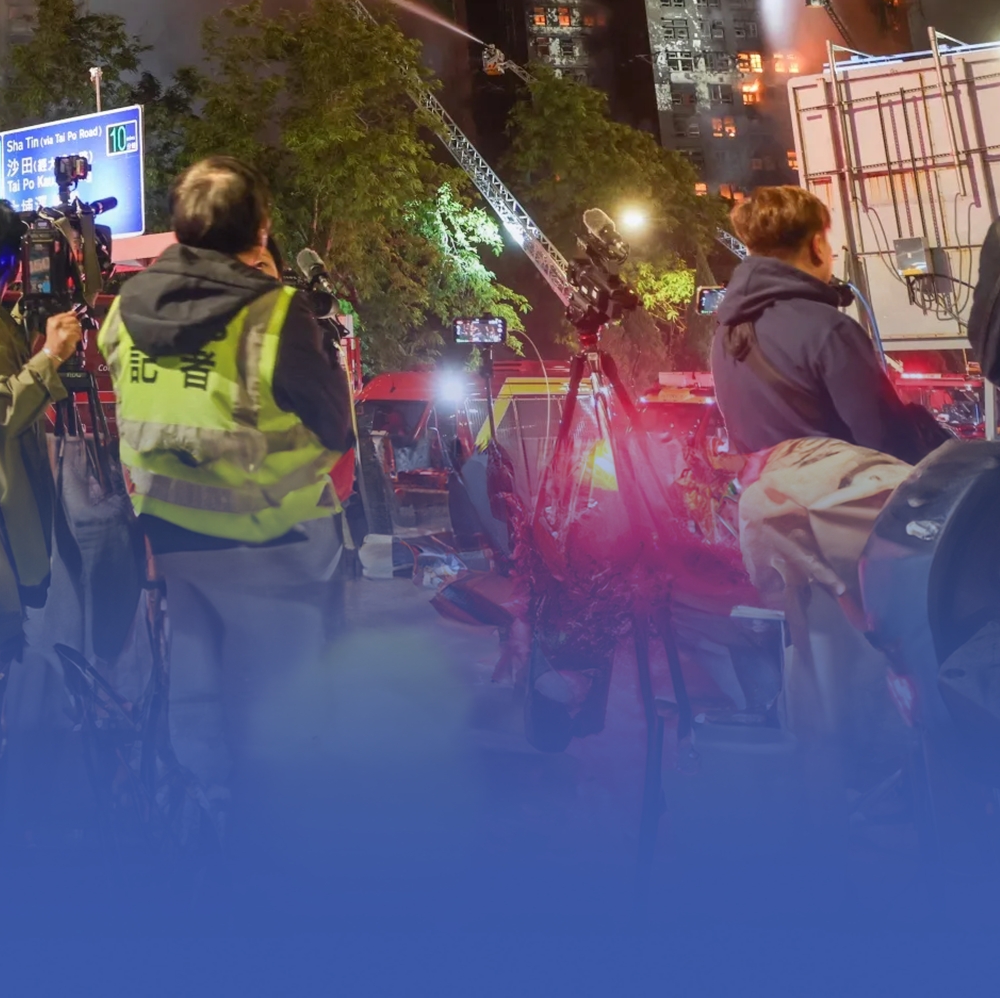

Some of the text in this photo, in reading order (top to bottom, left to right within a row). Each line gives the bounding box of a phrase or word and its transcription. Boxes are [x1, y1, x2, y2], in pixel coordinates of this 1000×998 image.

[7, 126, 102, 153] Sha Tin (via Tai Po Road)
[110, 125, 126, 152] 10
[7, 179, 20, 193] Tai
[23, 178, 35, 191] Po
